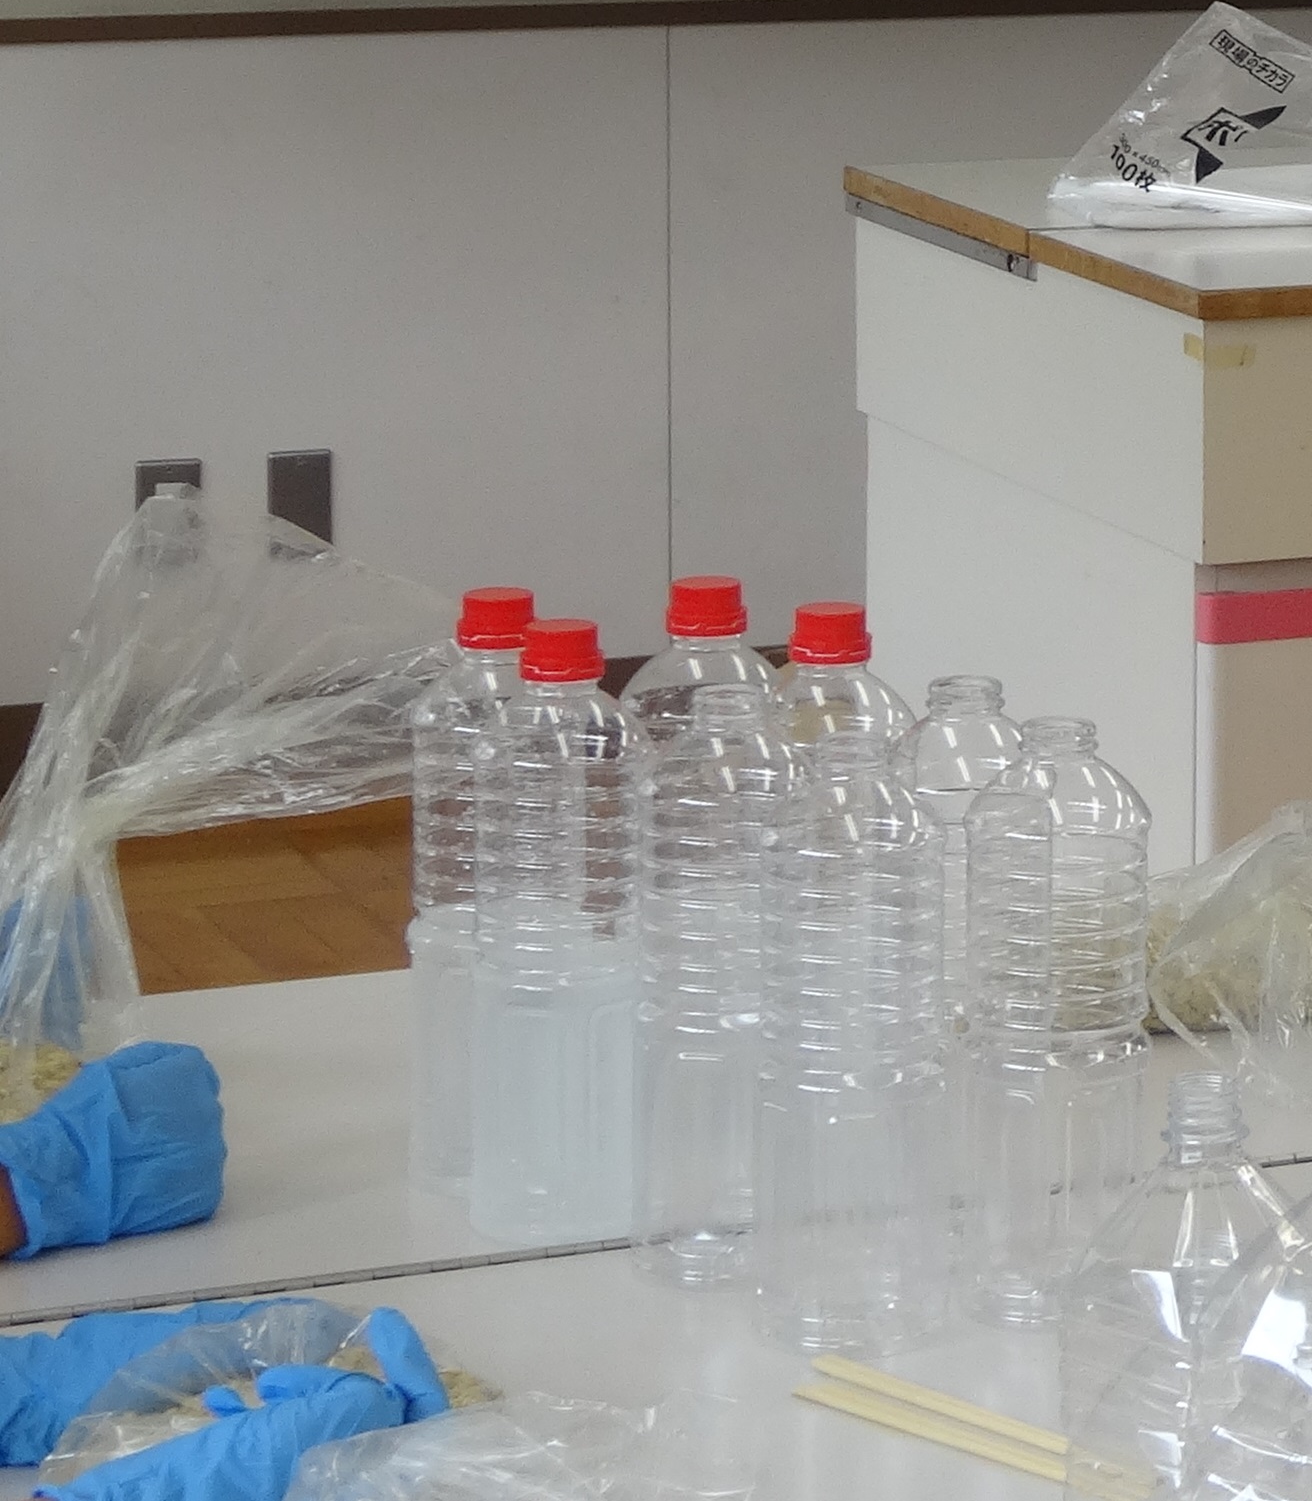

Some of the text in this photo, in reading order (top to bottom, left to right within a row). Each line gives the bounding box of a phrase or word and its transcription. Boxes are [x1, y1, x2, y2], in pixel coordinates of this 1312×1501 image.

[1217, 35, 1289, 87] 現場のチカラ
[1110, 145, 1157, 193] 100枚
